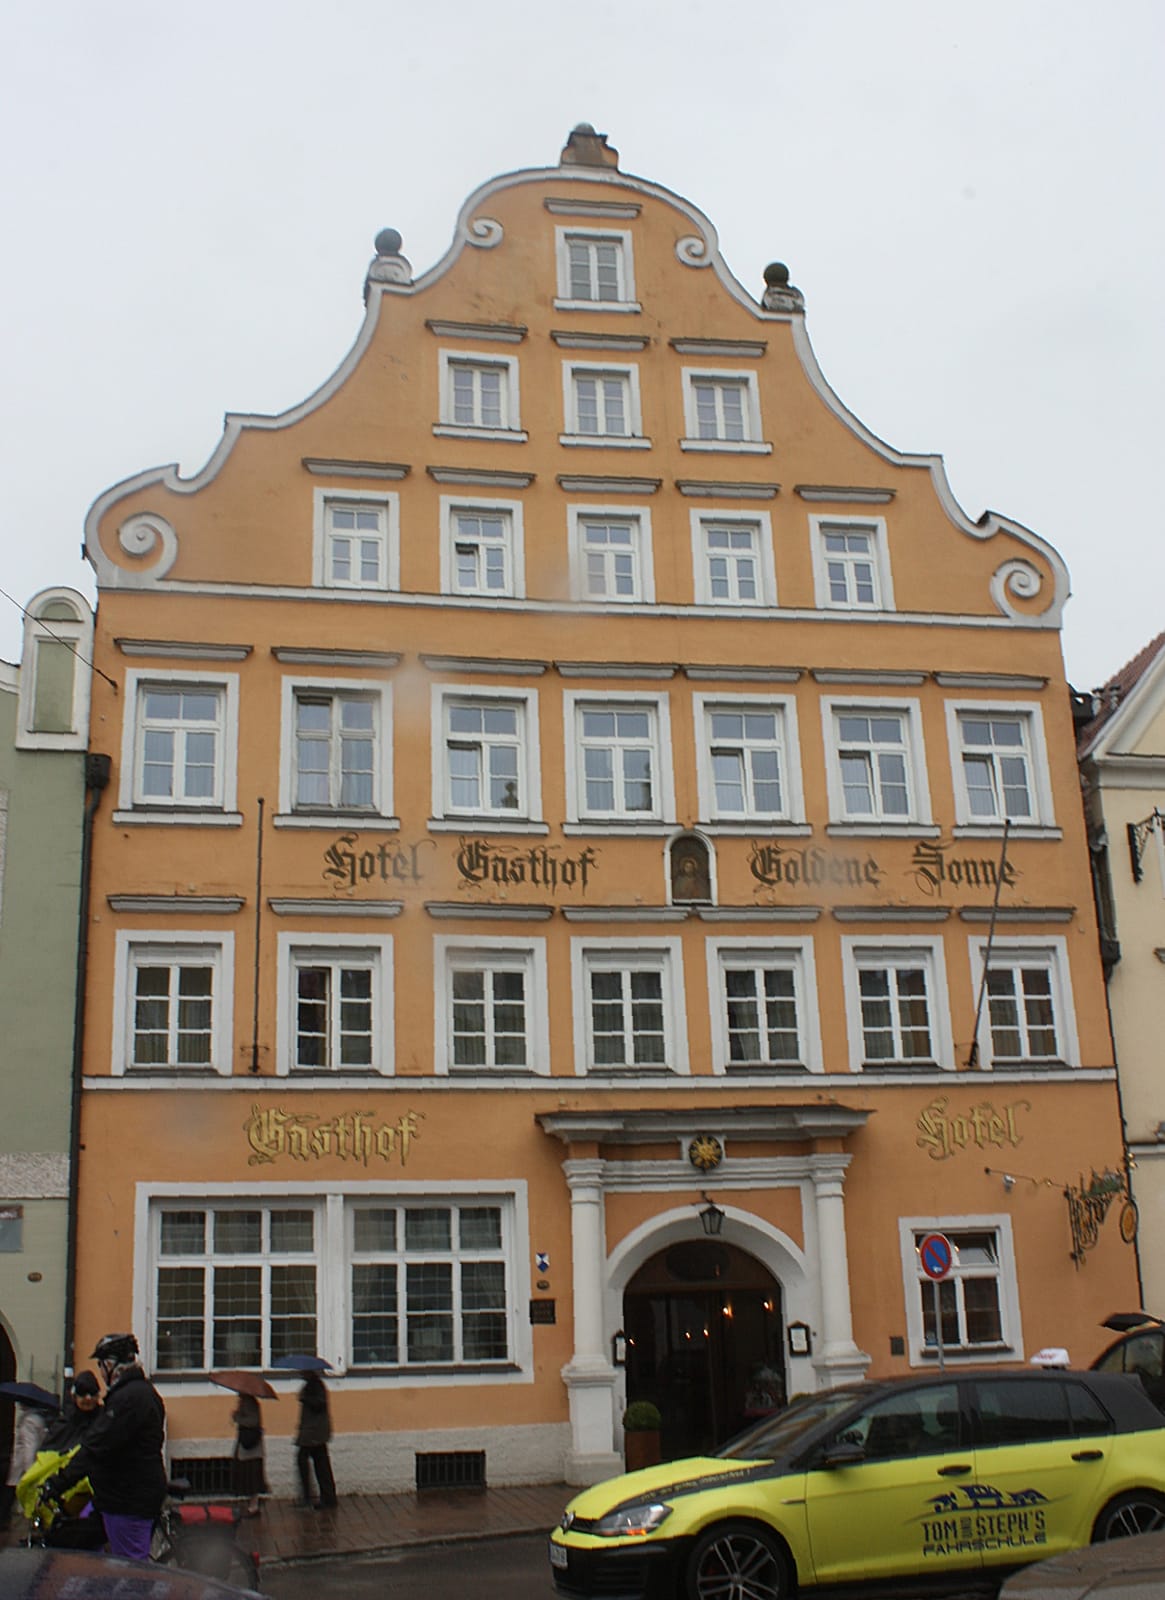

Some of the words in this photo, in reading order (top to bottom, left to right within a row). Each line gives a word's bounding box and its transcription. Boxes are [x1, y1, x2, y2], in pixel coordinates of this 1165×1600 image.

[322, 831, 437, 890] Hotel
[449, 835, 601, 897] Gasthof
[746, 840, 888, 895] Goldene
[903, 840, 1024, 897] Sonne
[243, 1103, 426, 1167] Gasthof
[915, 1096, 1031, 1160] Hotel
[921, 1520, 958, 1542] TOM
[976, 1510, 1046, 1536] STEPH'S
[922, 1532, 1046, 1556] FAHRSCHULE
